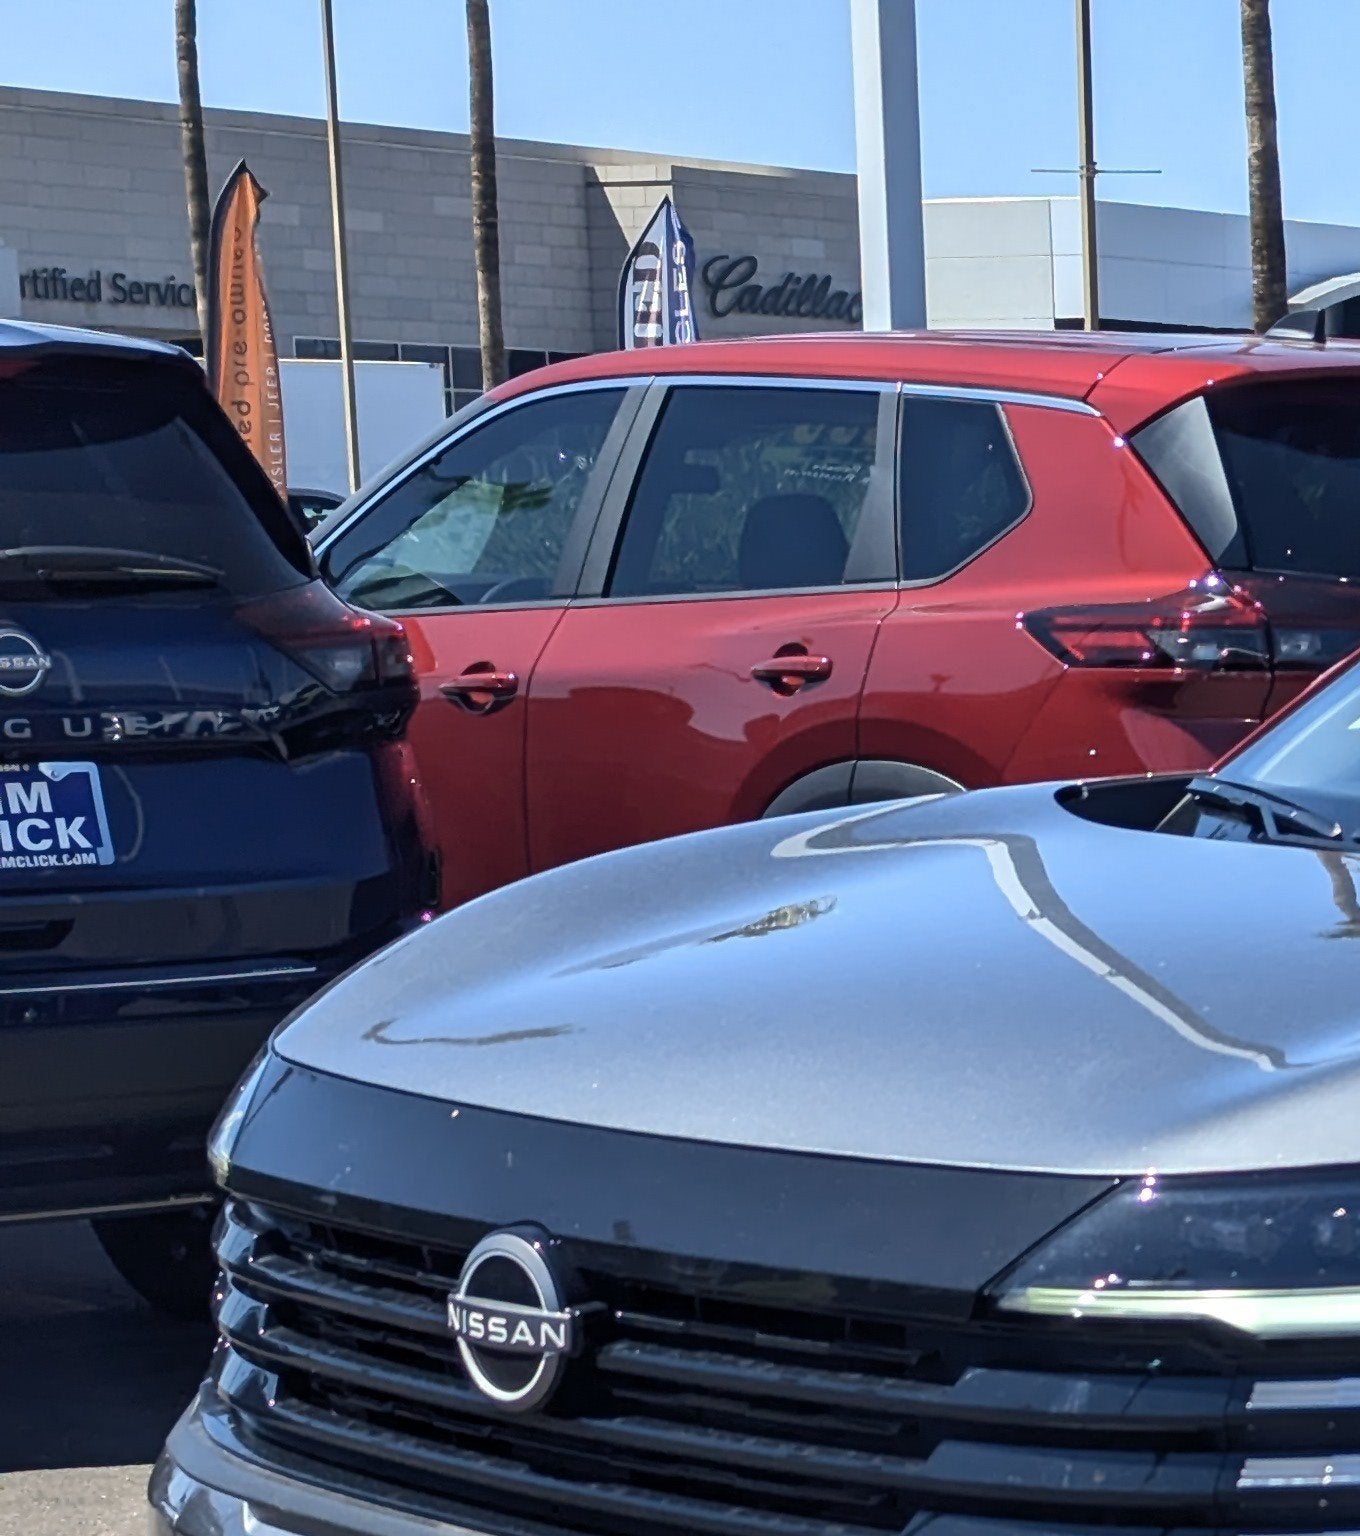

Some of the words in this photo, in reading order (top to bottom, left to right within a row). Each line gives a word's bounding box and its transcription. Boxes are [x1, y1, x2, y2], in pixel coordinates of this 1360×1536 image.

[111, 272, 197, 307] Servic
[269, 431, 284, 491] YSLER
[0, 781, 53, 815] M
[0, 852, 97, 869] MCLICK.COM
[446, 1300, 566, 1349] NISSAN
